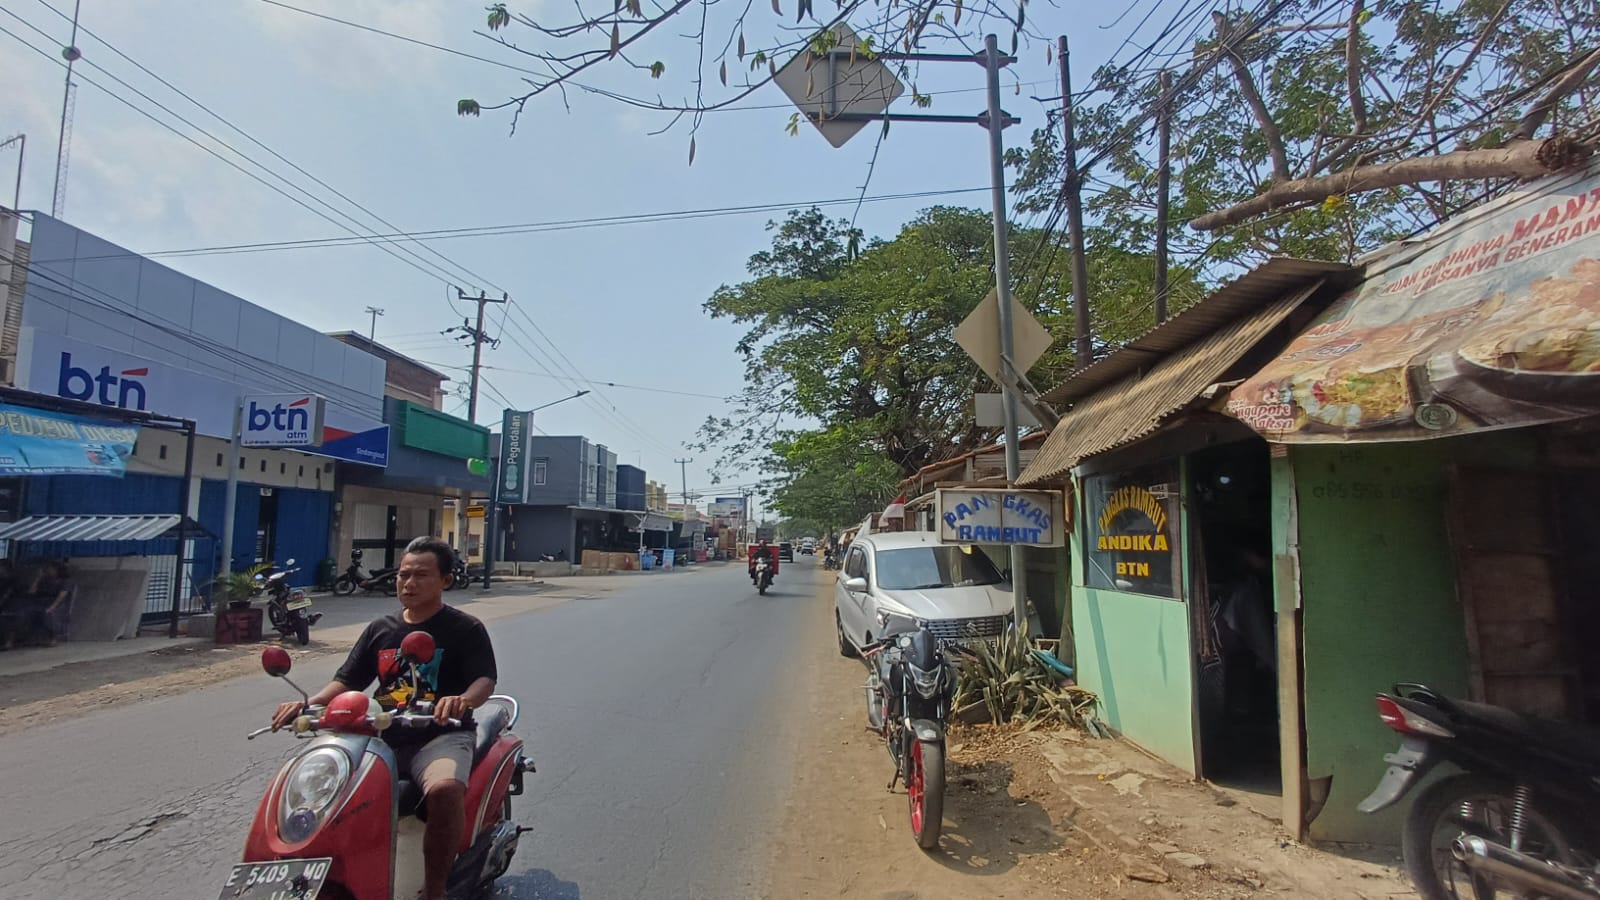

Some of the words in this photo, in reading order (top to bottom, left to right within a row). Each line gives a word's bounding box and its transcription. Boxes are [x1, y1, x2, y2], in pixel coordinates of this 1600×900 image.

[58, 351, 148, 410] btn
[248, 397, 310, 431] btn
[287, 430, 307, 439] atm
[1130, 485, 1167, 533] RAMBUT
[960, 524, 1041, 544] RAMBUT
[1097, 534, 1168, 551] ANDIKA
[1116, 562, 1149, 576] BTN
[226, 867, 241, 886] E
[246, 864, 289, 885] 5409
